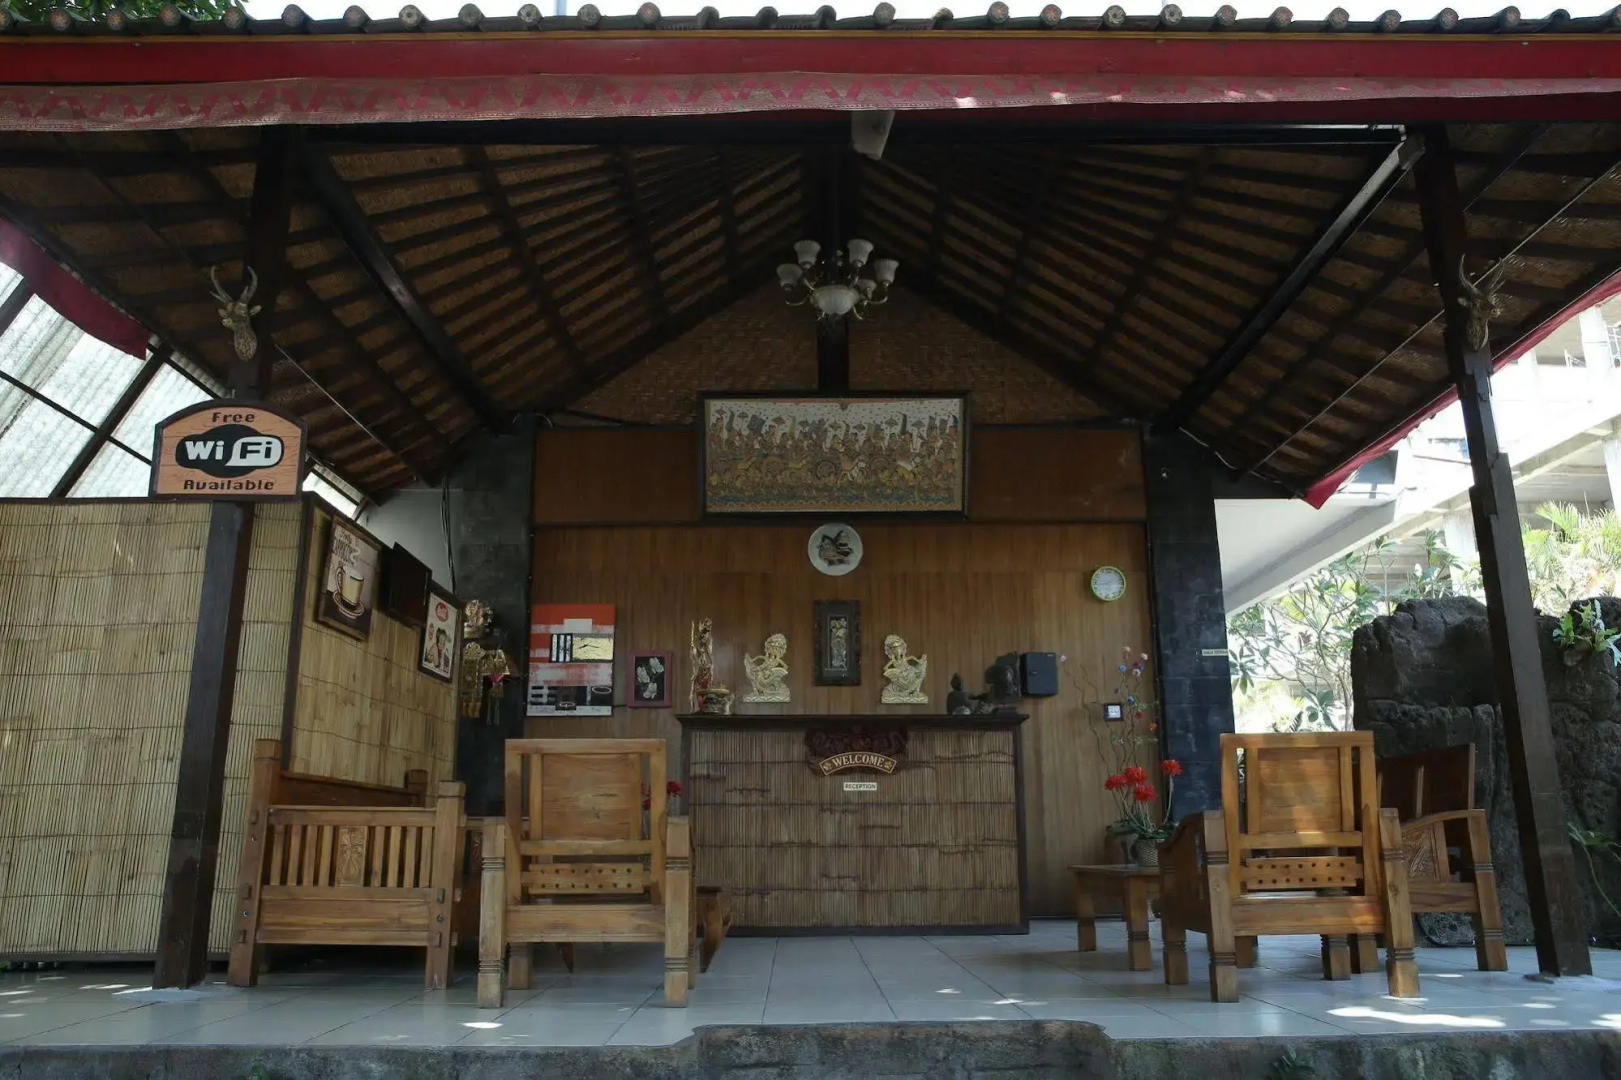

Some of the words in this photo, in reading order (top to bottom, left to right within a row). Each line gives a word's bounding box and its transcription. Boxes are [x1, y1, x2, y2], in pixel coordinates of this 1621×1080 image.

[212, 412, 256, 423] Free
[183, 479, 275, 491] Available
[832, 754, 885, 768] WELCOME
